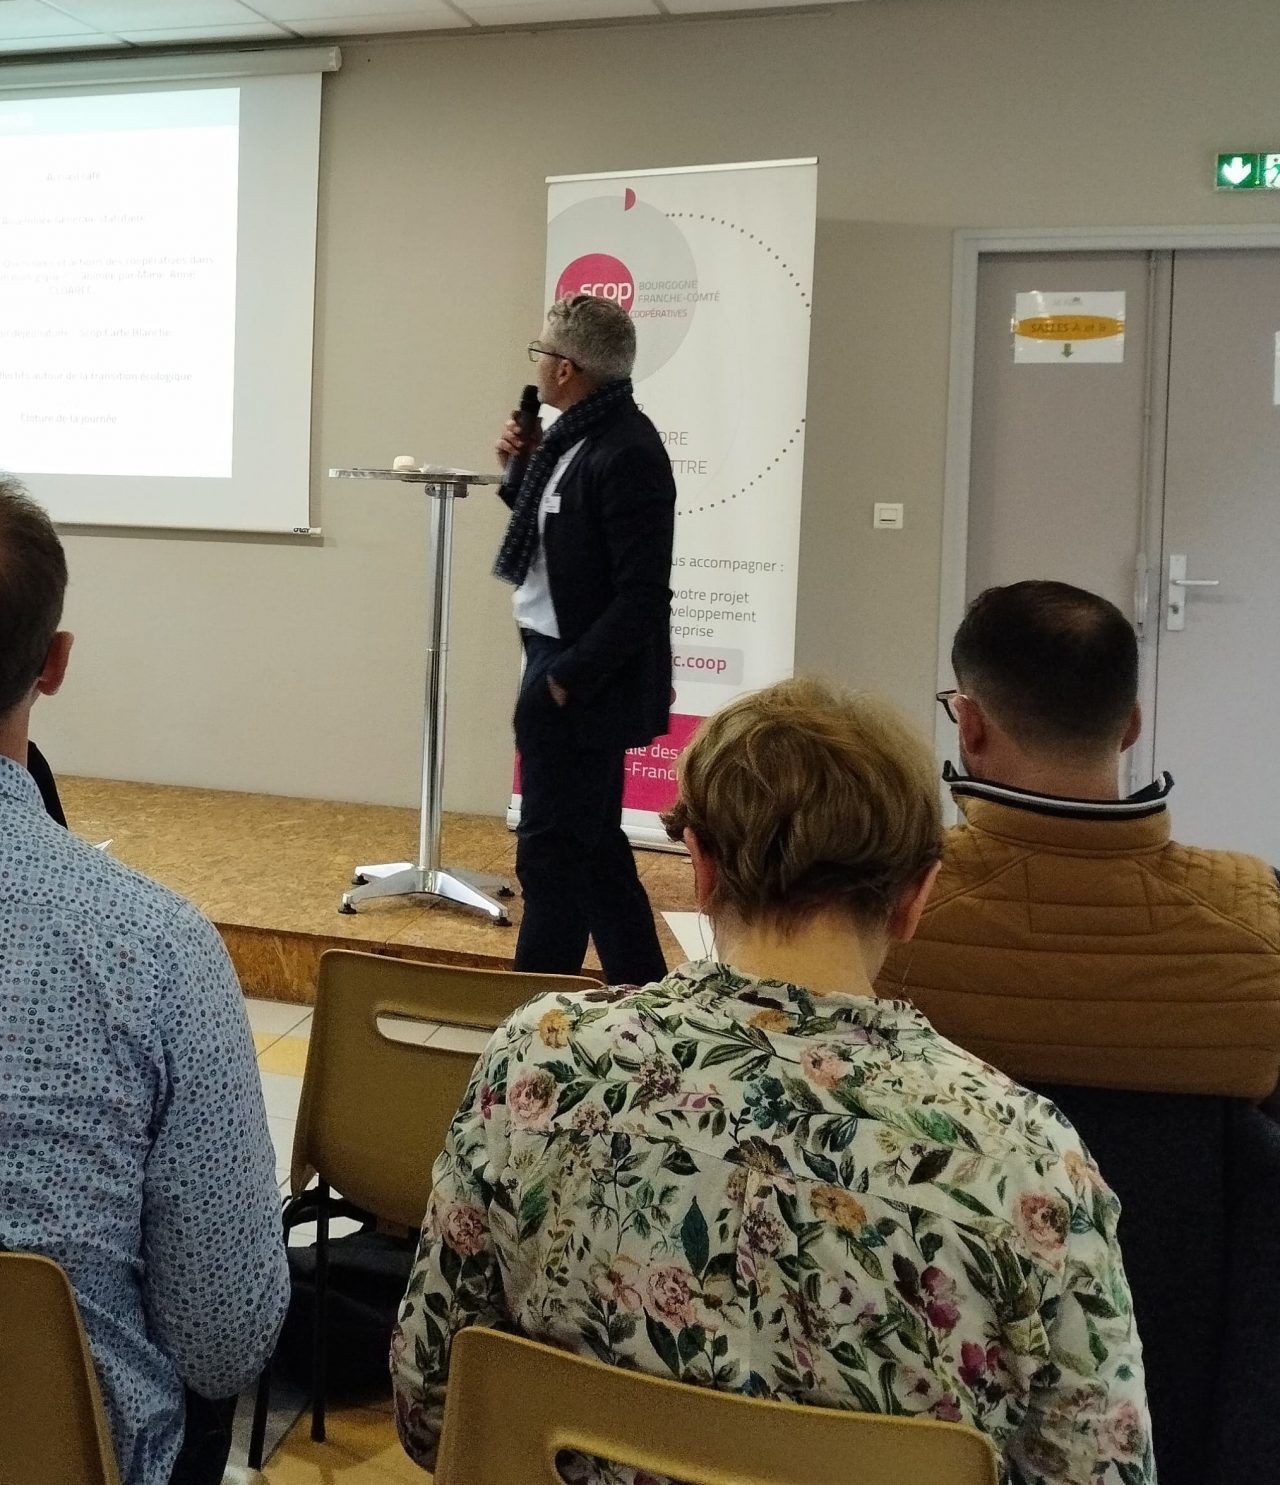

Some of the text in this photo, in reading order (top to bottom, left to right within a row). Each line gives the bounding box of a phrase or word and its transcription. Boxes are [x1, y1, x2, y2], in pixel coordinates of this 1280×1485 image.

[639, 280, 698, 291] BOURGOGNE
[638, 290, 720, 304] FRANCHE-COMTÉ
[630, 309, 688, 319] COOPÉRATIVES
[689, 557, 777, 574] accompagner
[672, 588, 750, 606] votre projet
[650, 743, 679, 760] des
